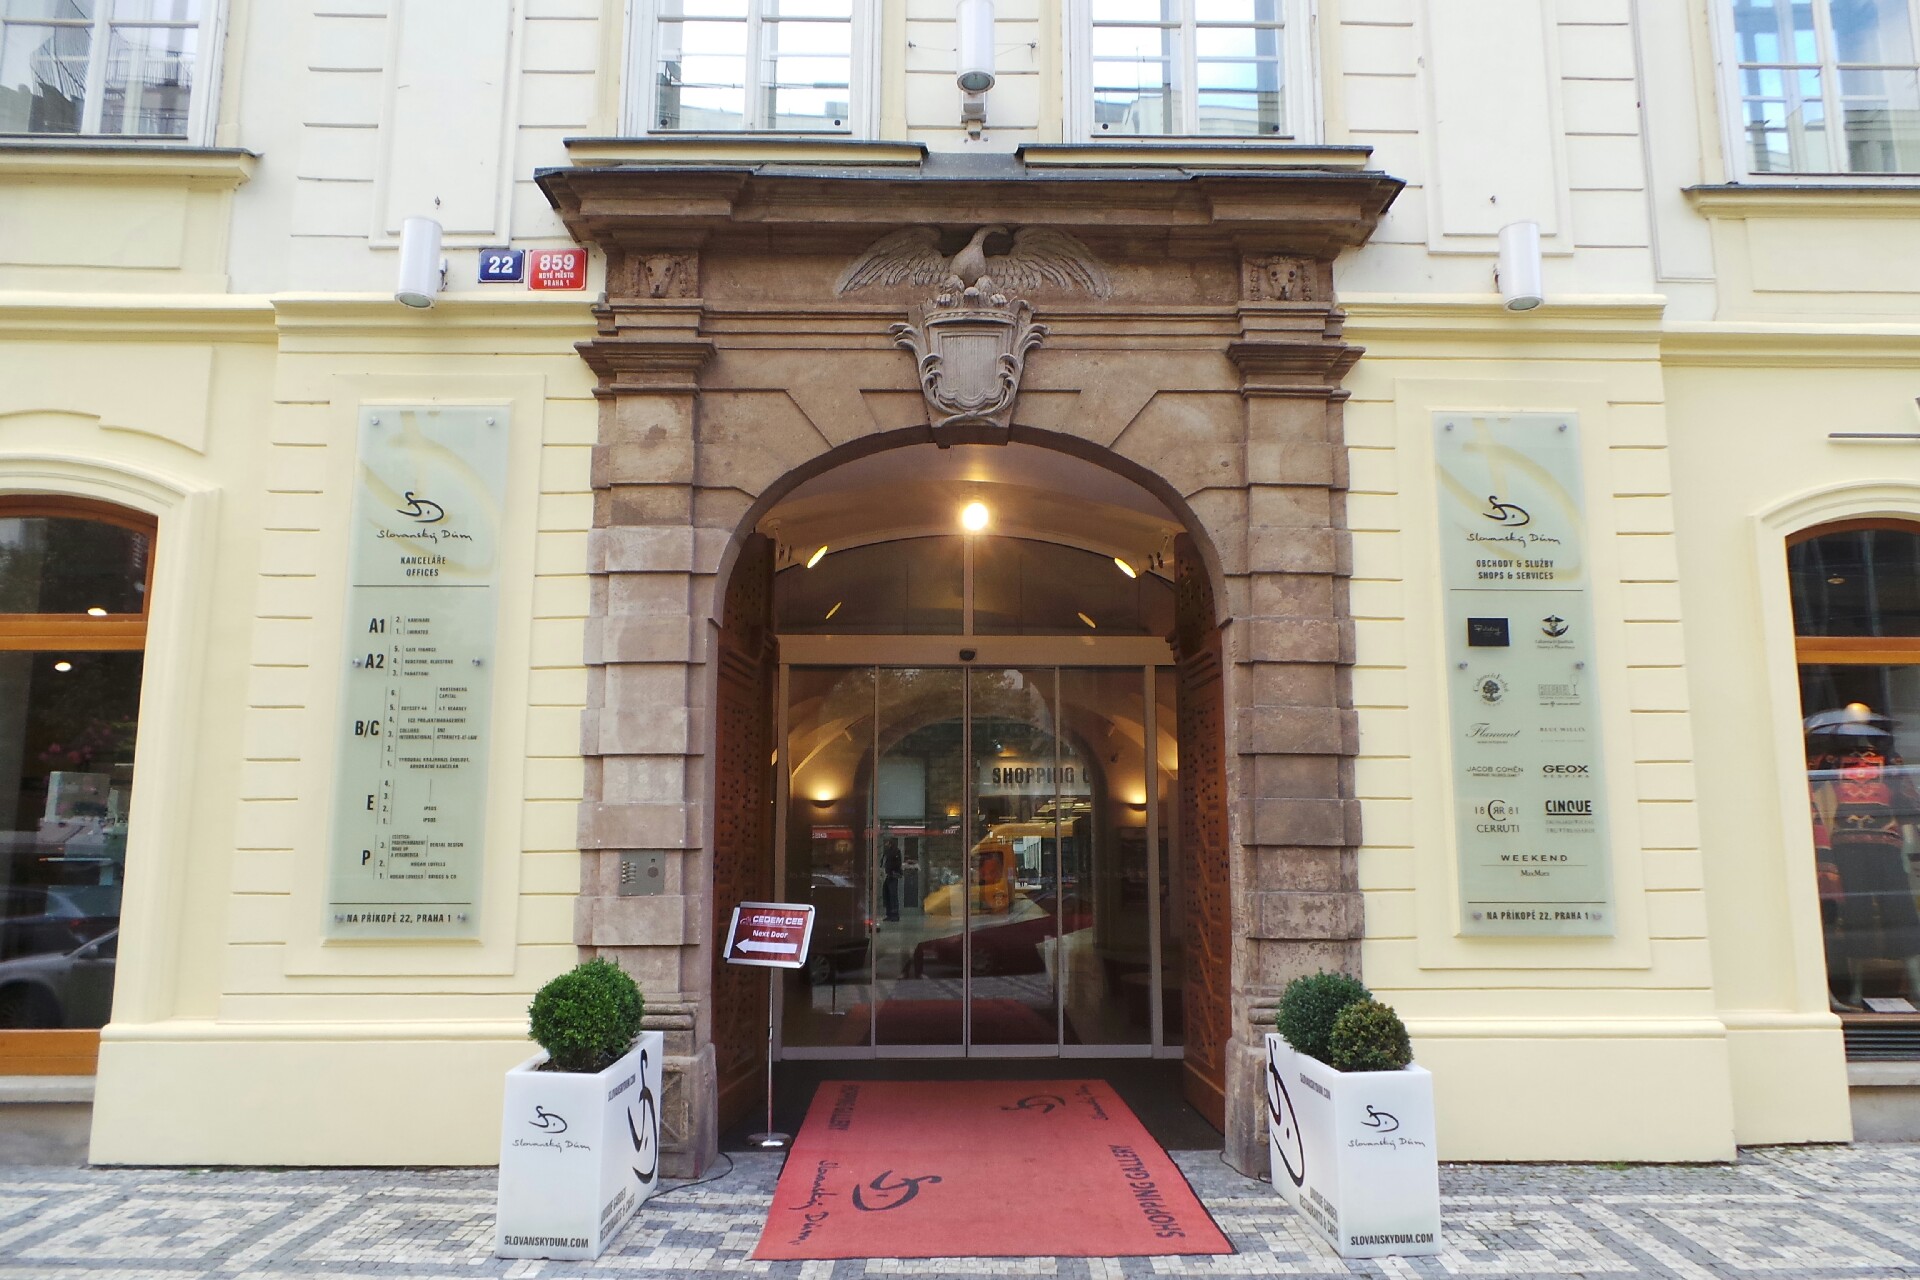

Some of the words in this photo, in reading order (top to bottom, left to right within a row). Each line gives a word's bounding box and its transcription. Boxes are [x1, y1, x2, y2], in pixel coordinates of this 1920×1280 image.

[488, 256, 514, 274] 22
[540, 254, 575, 271] 859
[539, 270, 554, 278] NOVÉ
[555, 270, 574, 278] MĚSTO
[400, 554, 446, 564] KANCELÁŘE
[1476, 560, 1513, 568] OBCHODY
[1516, 560, 1522, 568] &
[1525, 558, 1554, 568] SLUŽBY
[406, 568, 439, 577] OFFICES
[1478, 572, 1504, 580] SHOPS
[1508, 572, 1513, 580] &
[1516, 572, 1554, 580] SERVICES
[369, 618, 385, 633] A1
[365, 654, 384, 669] A2
[355, 720, 380, 738] B/C
[992, 767, 1074, 783] SHOPPING
[1543, 765, 1588, 773] GEOX
[367, 795, 374, 810] E
[1546, 800, 1591, 812] CINQUE
[1476, 824, 1520, 833] CERRUTI
[362, 850, 370, 866] P
[347, 914, 358, 922] NA
[361, 912, 396, 922] PŘÍKOPĚ
[400, 914, 413, 923] 22,
[417, 914, 444, 922] PRAHA
[753, 916, 784, 924] CEDEM
[1487, 912, 1498, 920] NA
[1501, 910, 1535, 920] PŘÍKOPĚ
[1555, 912, 1581, 920] PRAHA
[1585, 912, 1589, 920] 1
[1108, 1144, 1150, 1180] GALLERY
[1130, 1182, 1186, 1238] SHOPPING
[504, 1235, 588, 1248] SLOVANSKYDUM.COM
[1351, 1233, 1433, 1246] SLOVANSKYDUM.COM
